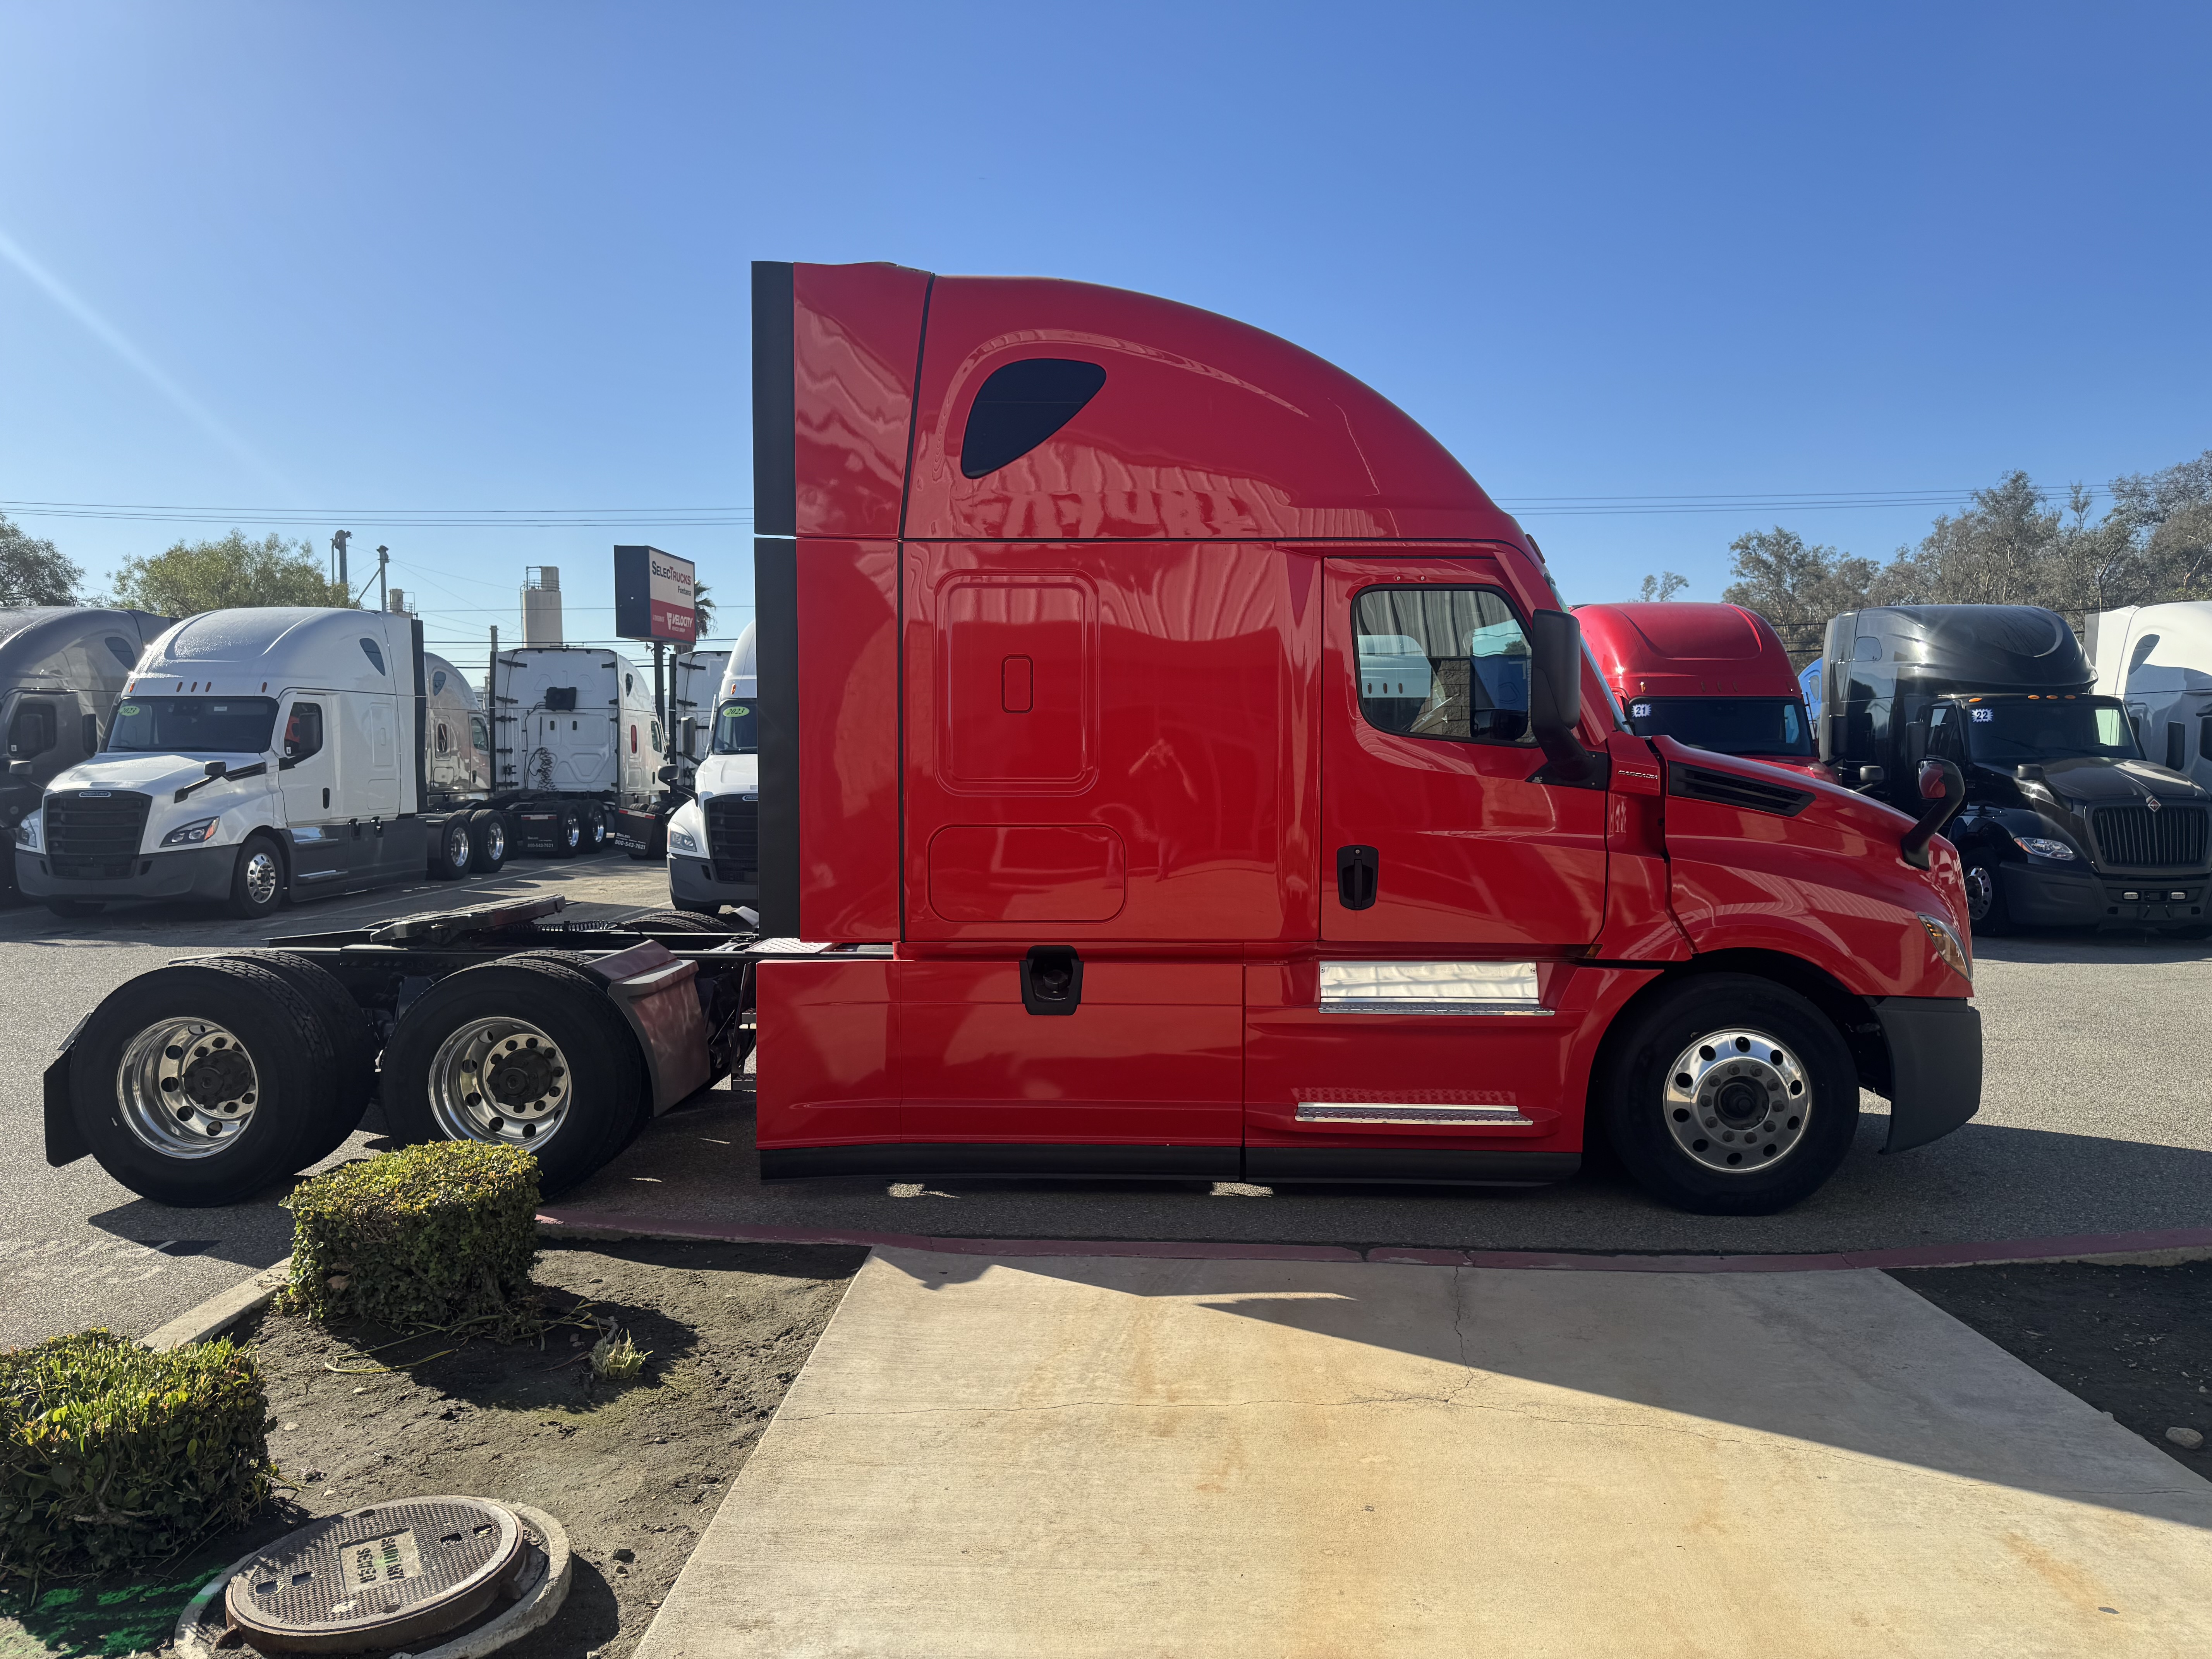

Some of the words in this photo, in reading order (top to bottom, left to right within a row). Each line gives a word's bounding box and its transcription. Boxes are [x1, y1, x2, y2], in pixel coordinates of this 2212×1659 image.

[678, 586, 691, 596] Fontana
[672, 613, 693, 628] VELOCITY
[1636, 706, 1646, 715] 21
[1976, 711, 1988, 720] 22
[1618, 770, 1659, 779] CASCADIA
[615, 839, 646, 850] 800-543-7621
[357, 1547, 376, 1583] SEWER
